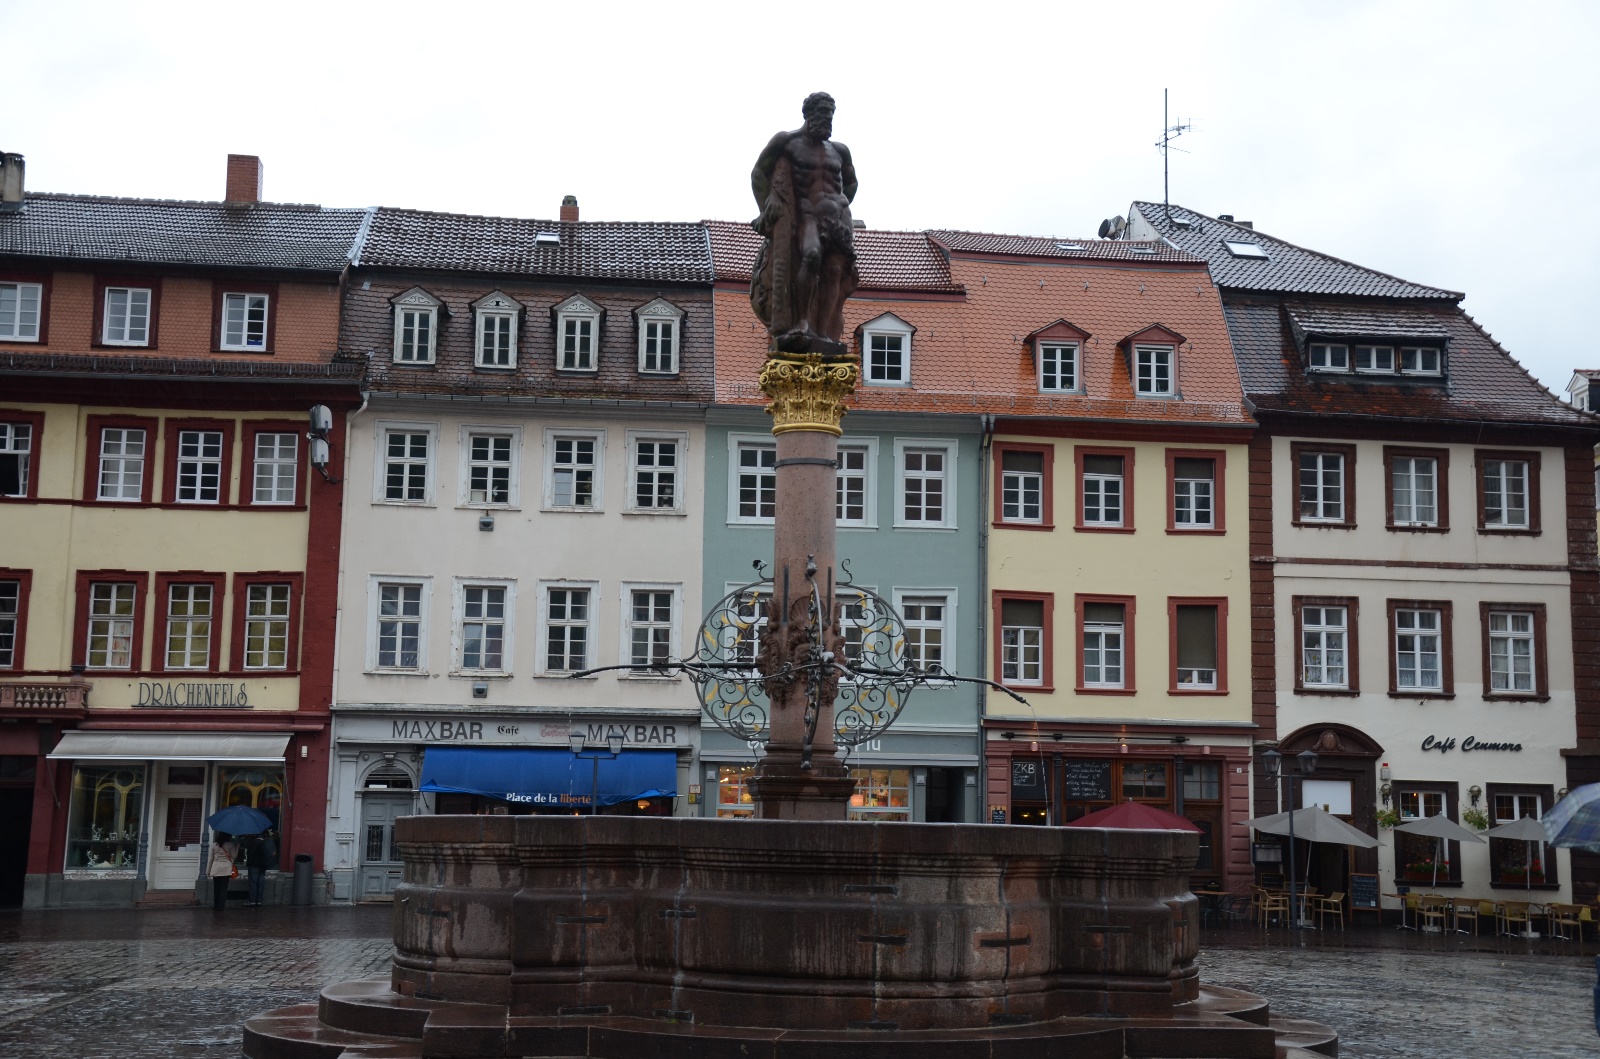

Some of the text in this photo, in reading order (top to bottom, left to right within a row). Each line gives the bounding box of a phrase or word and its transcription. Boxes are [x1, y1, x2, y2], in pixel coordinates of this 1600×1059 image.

[137, 682, 248, 706] DRACHENFELS
[1421, 734, 1523, 754] Café Cenmoro
[1013, 763, 1035, 774] ZKB
[506, 792, 592, 804] Place de la liberté
